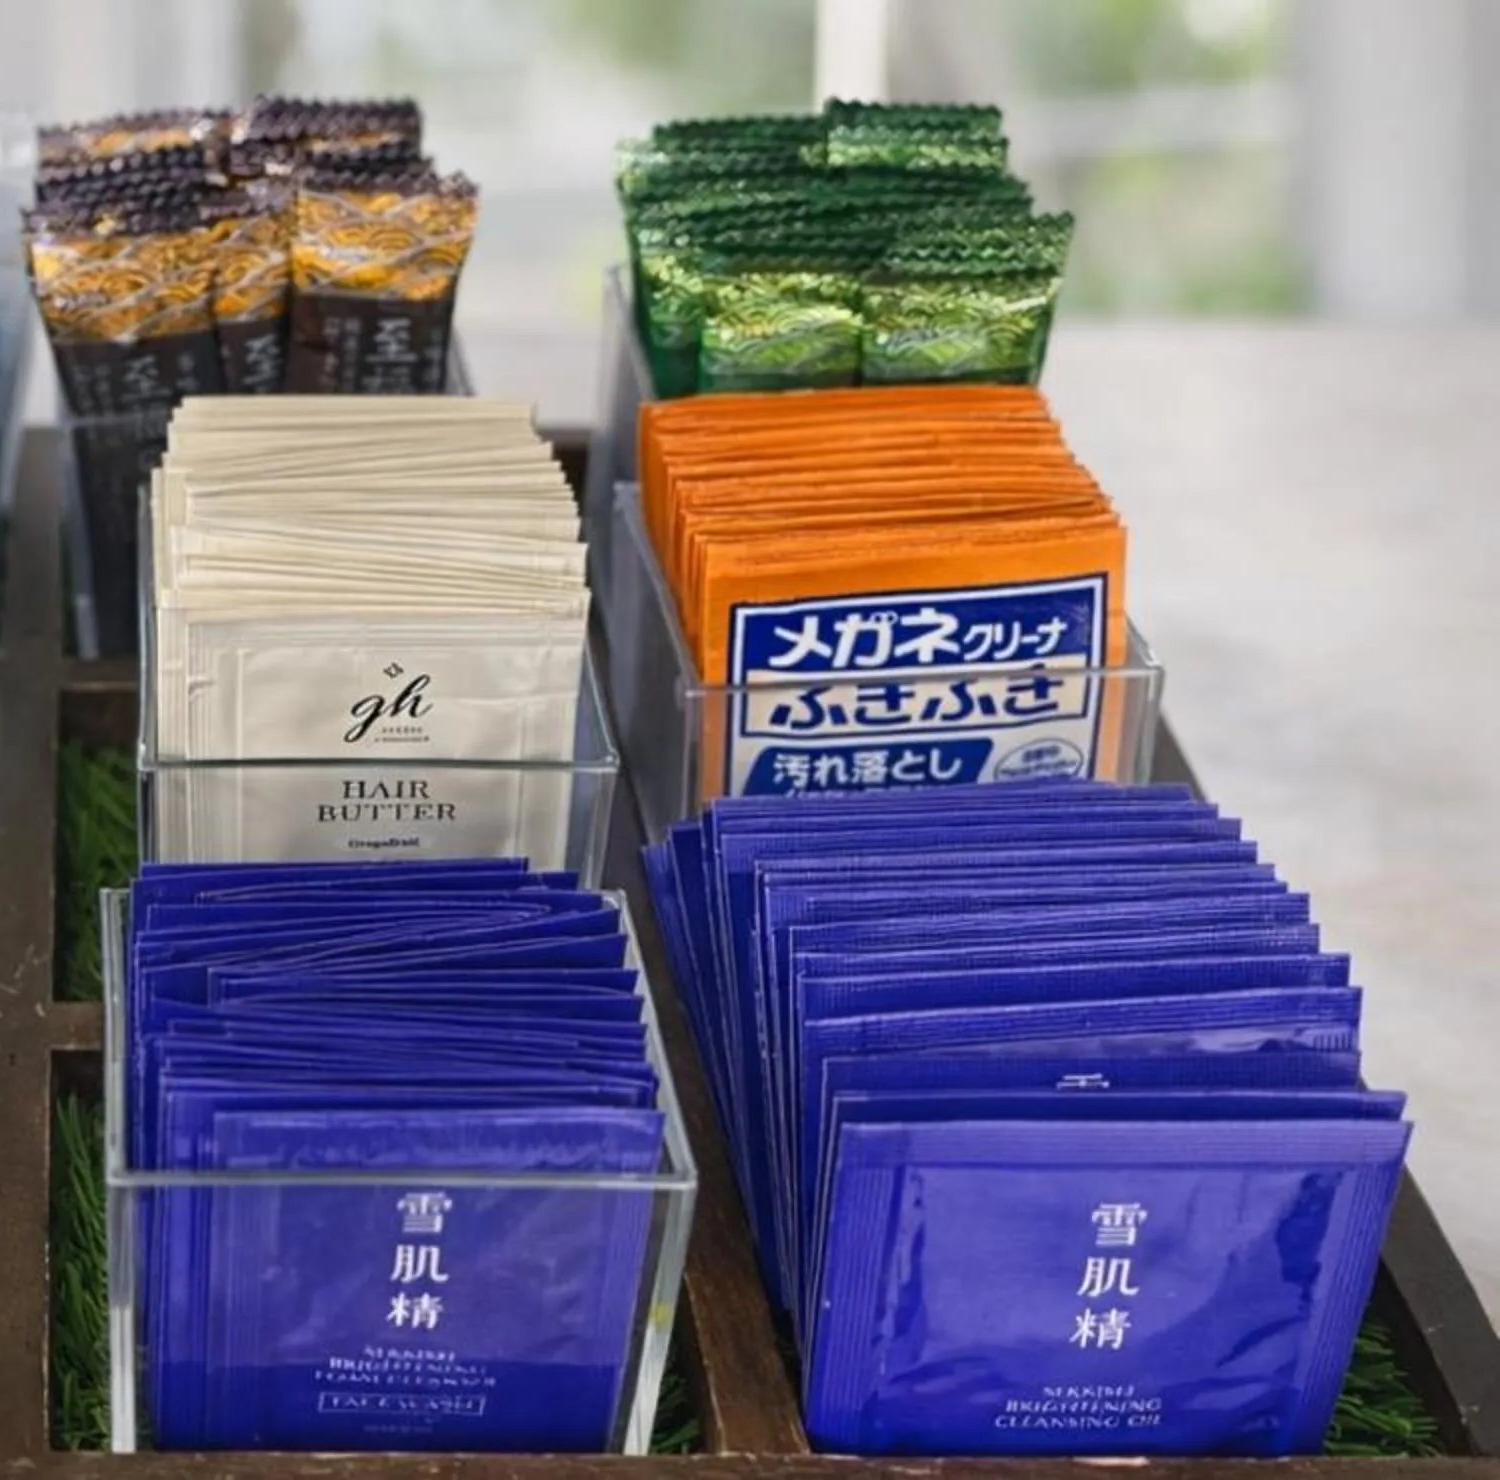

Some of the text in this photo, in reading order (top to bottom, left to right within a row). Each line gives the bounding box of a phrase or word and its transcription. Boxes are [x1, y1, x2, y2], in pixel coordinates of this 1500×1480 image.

[343, 673, 433, 743] gh
[342, 780, 431, 800] HAIR
[772, 748, 963, 787] 汚れ落とし
[316, 802, 458, 823] BUTTER
[386, 1191, 453, 1329] 雪肌精
[1069, 1202, 1148, 1350] 雪肌精
